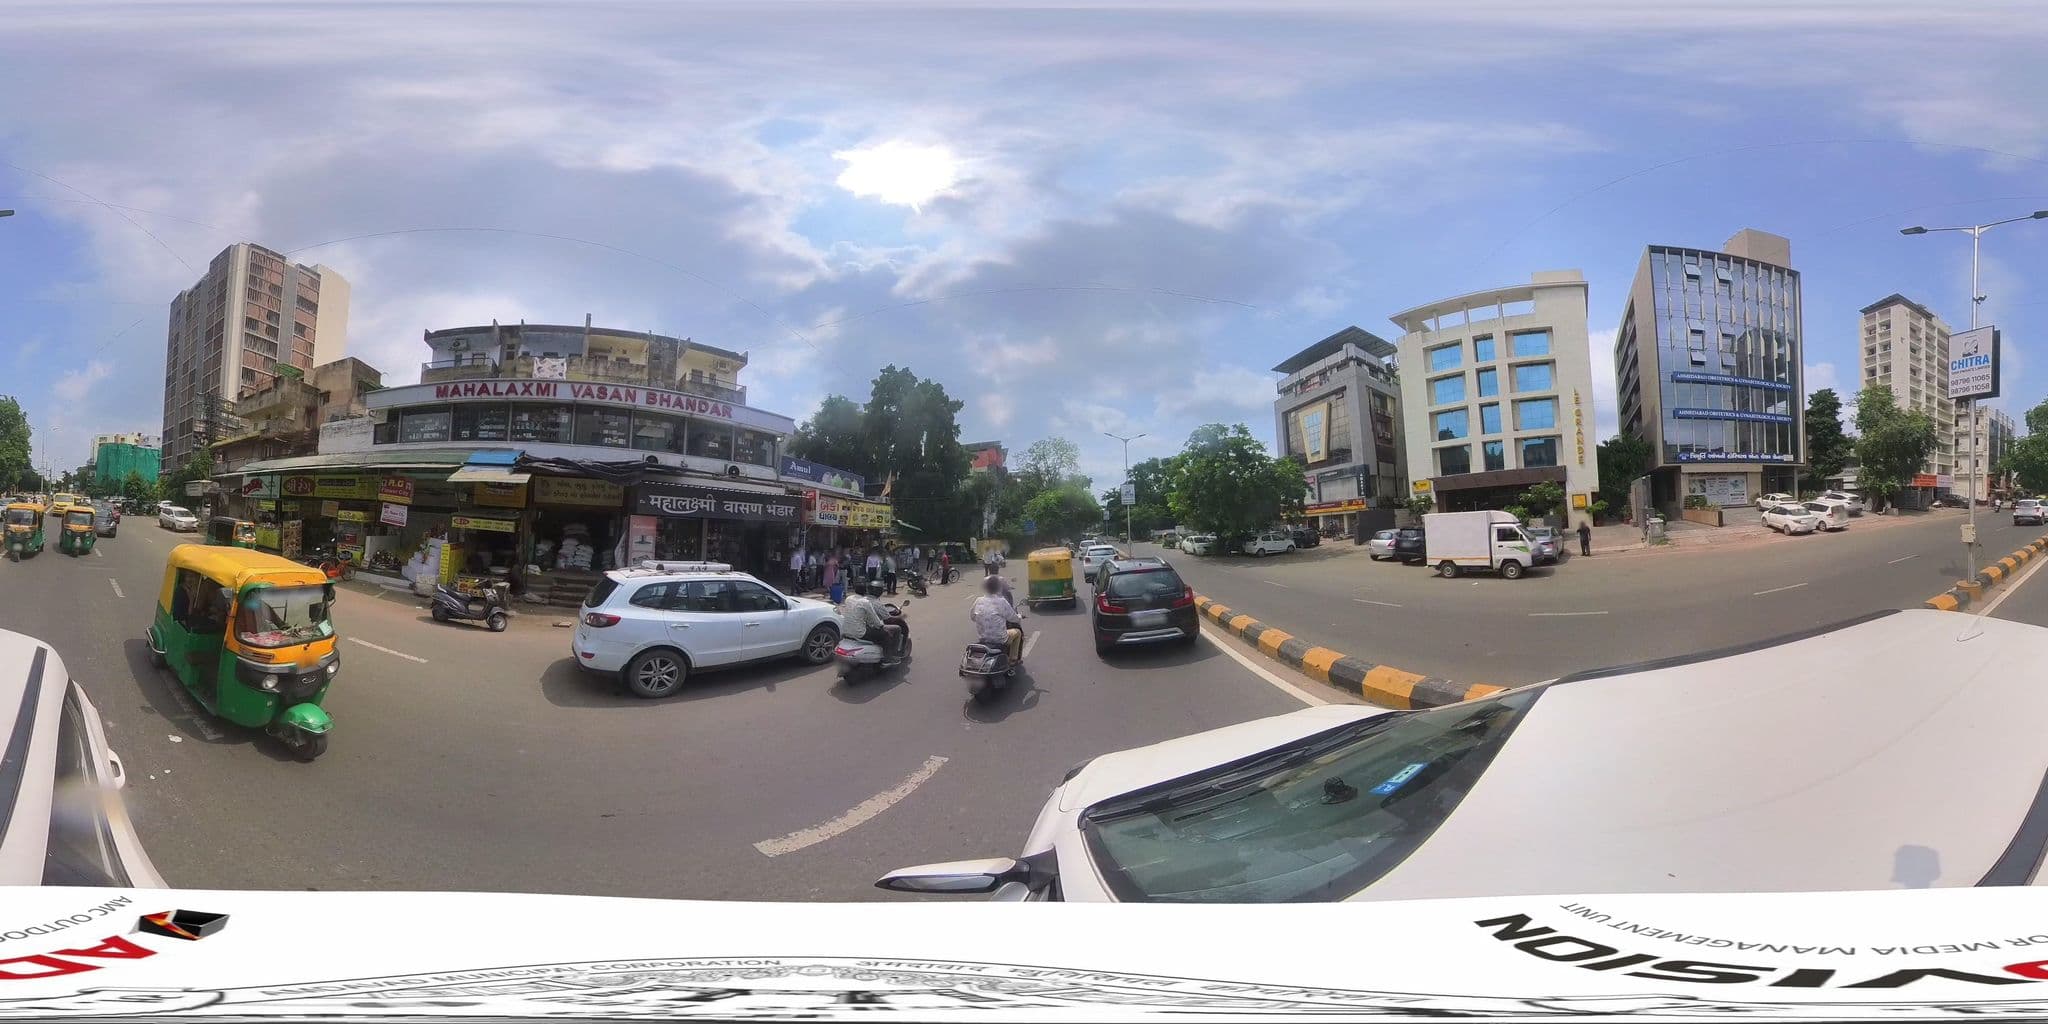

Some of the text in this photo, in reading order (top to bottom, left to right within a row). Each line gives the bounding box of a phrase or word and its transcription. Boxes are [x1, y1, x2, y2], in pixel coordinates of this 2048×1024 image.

[1951, 354, 1990, 370] CHITRA
[1971, 373, 1990, 383] 11065
[435, 382, 734, 419] MAHALAXMI VASAN BHANDAR
[1575, 408, 1585, 465] GRANDE
[790, 461, 811, 474] Amul
[649, 493, 796, 517] महालक्ष्मी वासण भंडार
